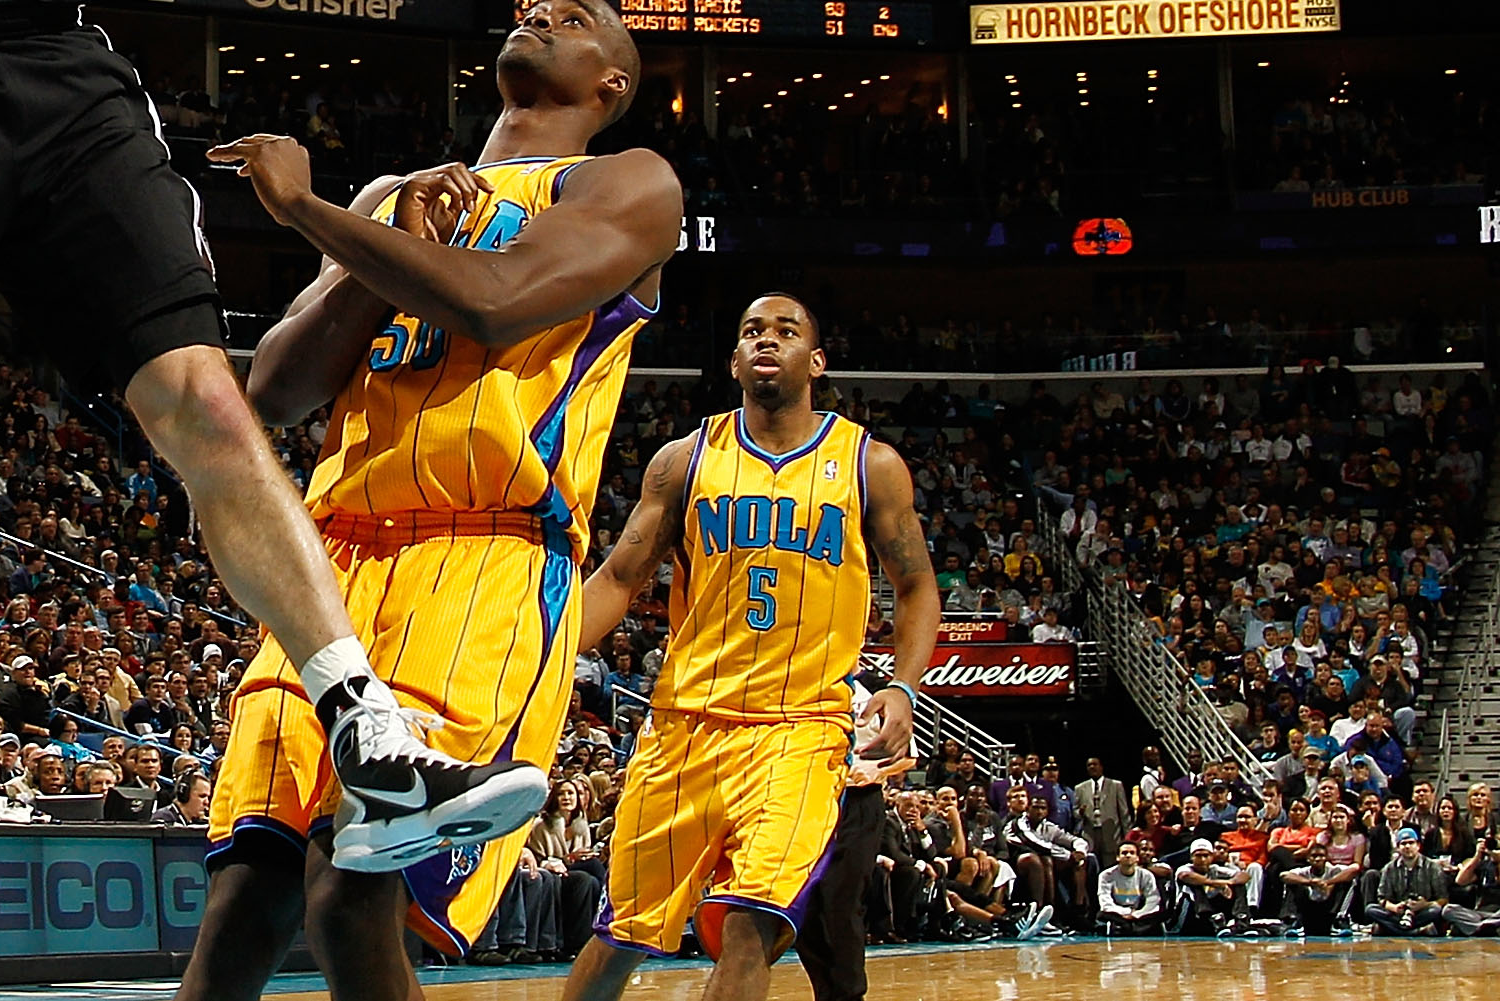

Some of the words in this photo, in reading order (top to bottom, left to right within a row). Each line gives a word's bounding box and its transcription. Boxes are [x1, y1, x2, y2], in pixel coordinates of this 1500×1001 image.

[879, 6, 889, 20] 2
[1006, 3, 1150, 40] HORNBECK
[1305, 16, 1338, 27] NYSE
[622, 14, 687, 31] HOUSTON
[694, 17, 760, 33] ROCKETS
[825, 20, 844, 36] 51
[1312, 190, 1355, 208] HUB
[1358, 188, 1410, 207] CLUB
[695, 496, 846, 567] NOLA
[746, 567, 778, 631] 5
[949, 632, 972, 641] EXIT
